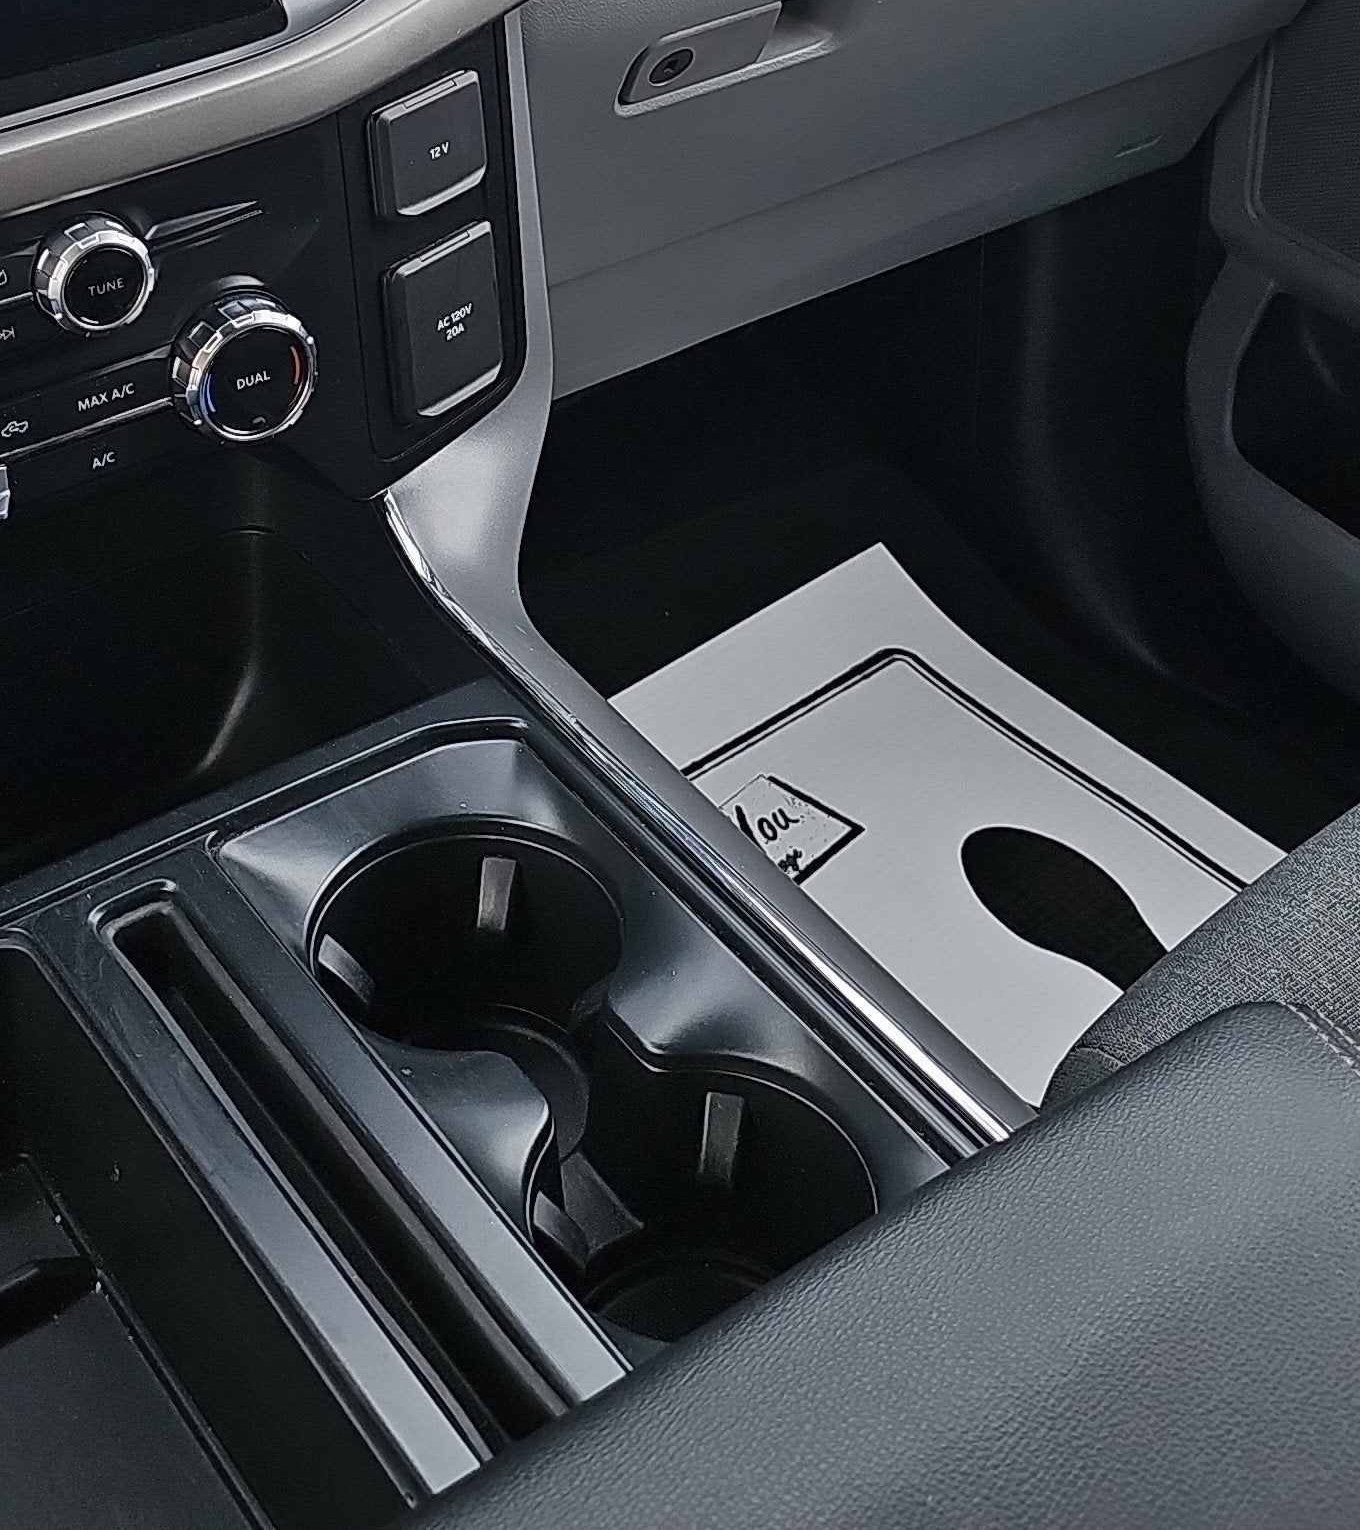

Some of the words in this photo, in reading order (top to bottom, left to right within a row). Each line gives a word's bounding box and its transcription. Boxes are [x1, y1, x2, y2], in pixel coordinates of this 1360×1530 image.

[88, 277, 125, 296] TUNE
[437, 316, 451, 331] AC
[451, 303, 472, 323] 120V
[445, 322, 465, 340] 20A
[236, 370, 271, 390] DUAL
[77, 391, 109, 411] MAX
[111, 382, 135, 400] A/C
[92, 451, 116, 469] A/C
